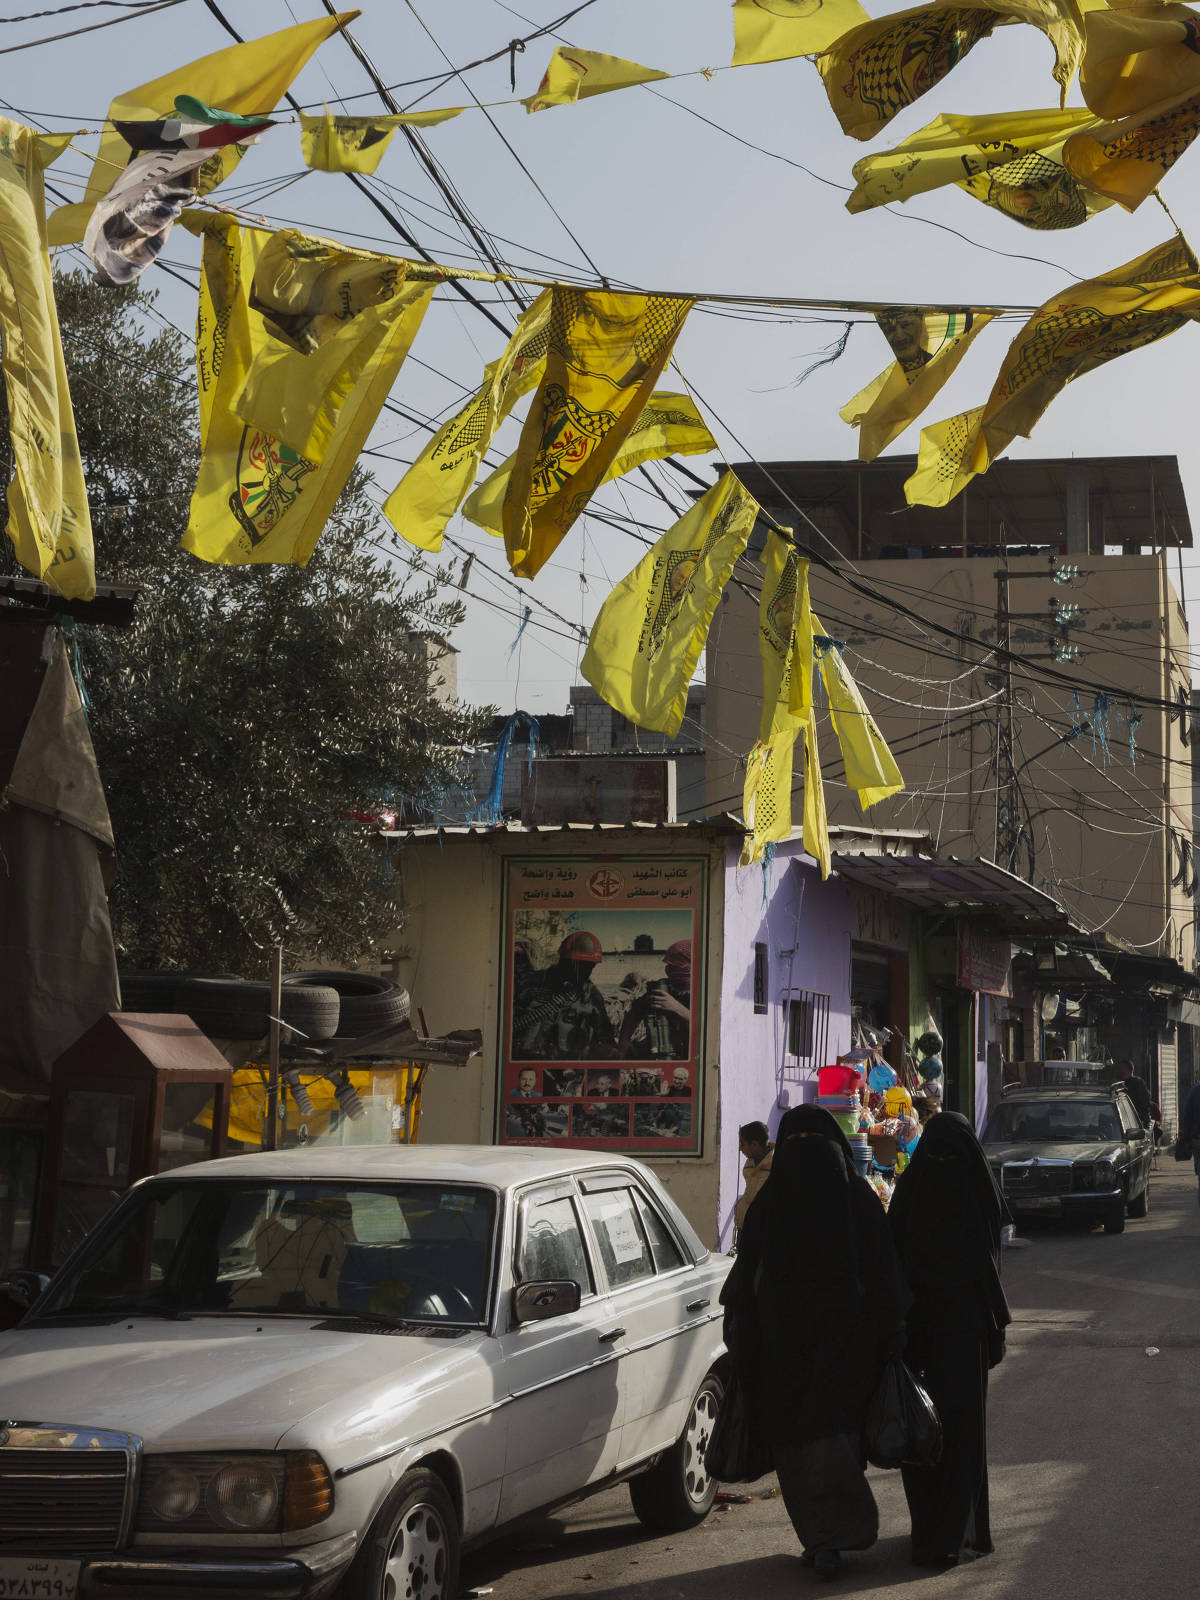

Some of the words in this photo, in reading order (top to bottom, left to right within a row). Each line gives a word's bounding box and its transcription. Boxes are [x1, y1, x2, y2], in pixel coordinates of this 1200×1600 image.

[520, 866, 554, 881] واضحة
[558, 866, 577, 881] رؤية
[633, 866, 663, 880] الشهيد
[664, 867, 689, 879] كتائب
[522, 887, 549, 901] واضح
[551, 888, 575, 899] هدف
[626, 887, 659, 899] مصطفى
[661, 888, 675, 899] علي
[676, 886, 694, 898] أبو
